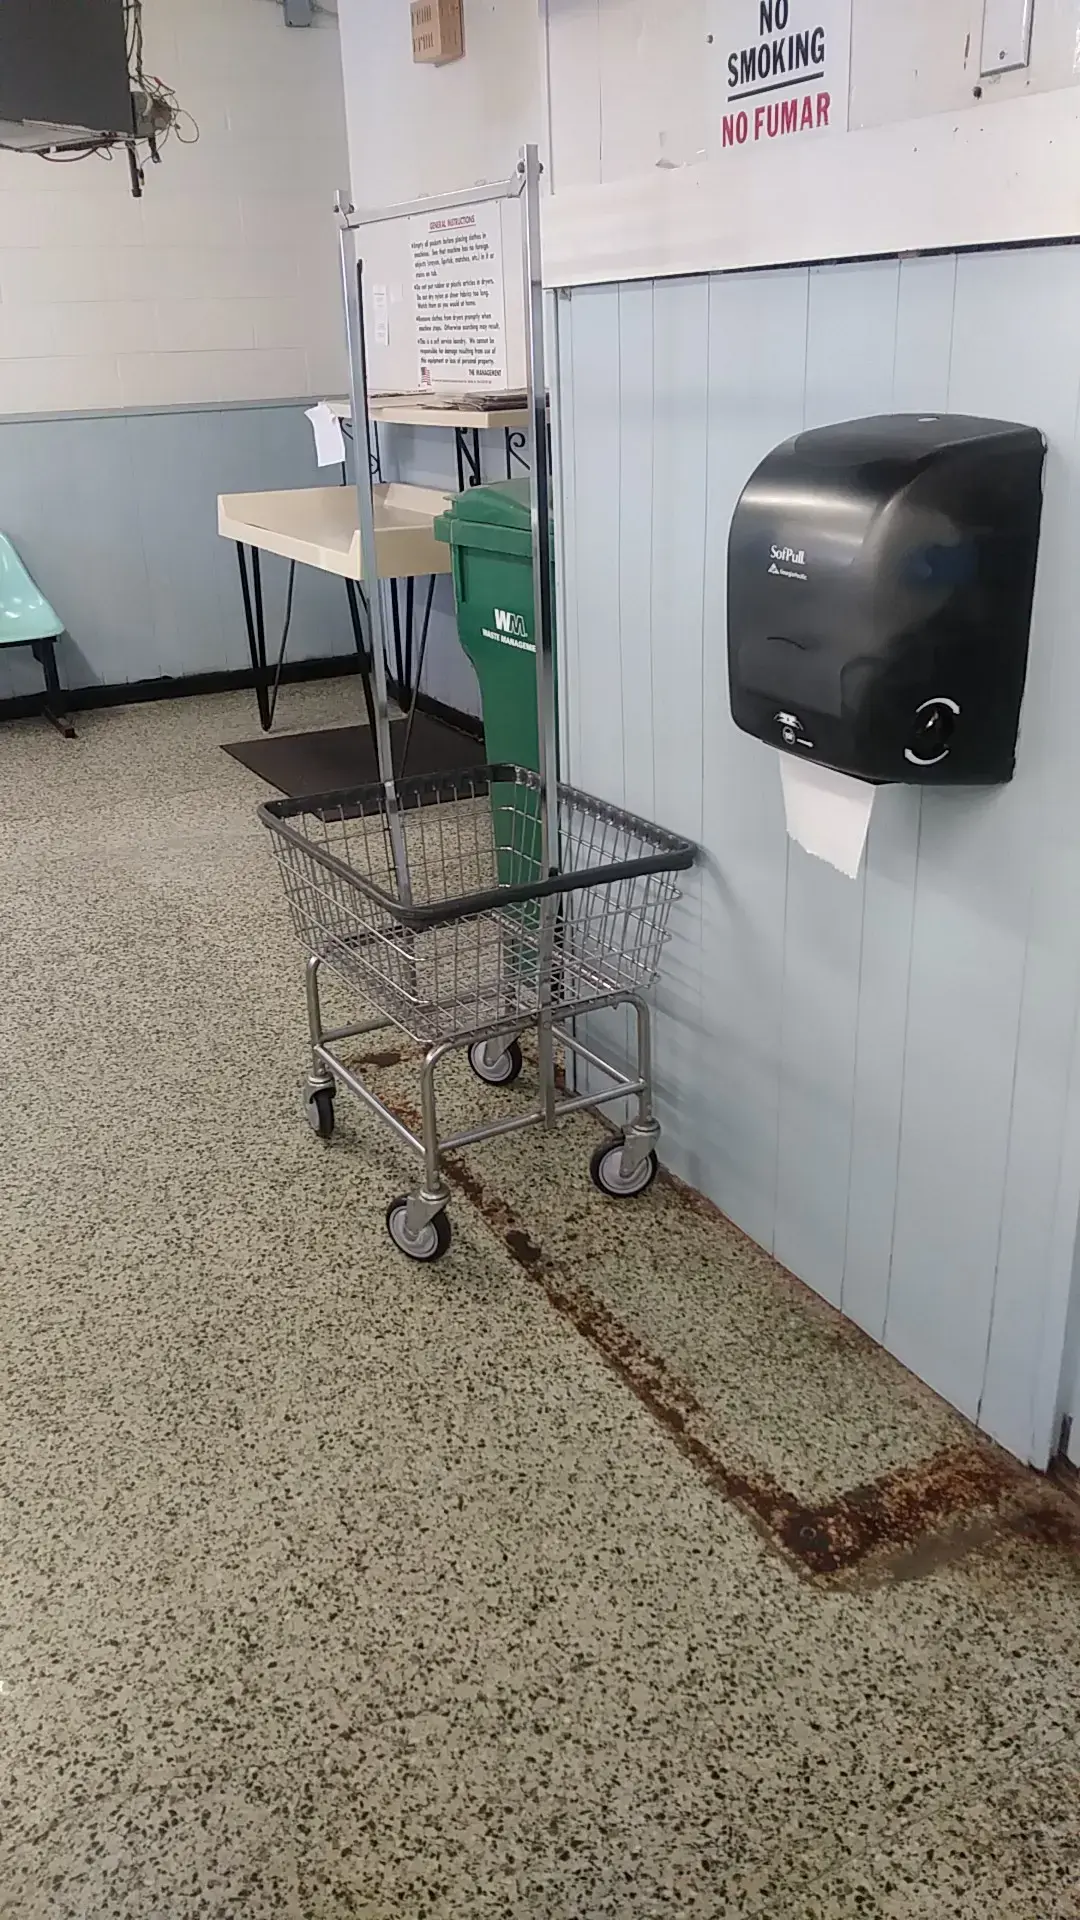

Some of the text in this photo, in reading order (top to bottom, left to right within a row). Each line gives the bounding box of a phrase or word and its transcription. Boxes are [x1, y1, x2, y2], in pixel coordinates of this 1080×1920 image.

[759, 0, 788, 35] NO
[728, 26, 825, 87] SMOKING
[722, 92, 830, 147] NO FUMAR
[429, 215, 475, 230] GENERAL INSTRUCTIONS
[430, 239, 441, 247] pockets
[443, 236, 454, 244] before
[455, 235, 467, 243] placing
[480, 289, 489, 297] long.
[453, 314, 463, 322] dryers
[464, 314, 480, 322] promptly
[488, 322, 500, 330] result.
[459, 348, 473, 356] resulting
[462, 358, 476, 366] personal
[477, 358, 494, 366] property.
[771, 545, 805, 565] SofPull
[482, 628, 537, 652] WASTE MANAGEME
